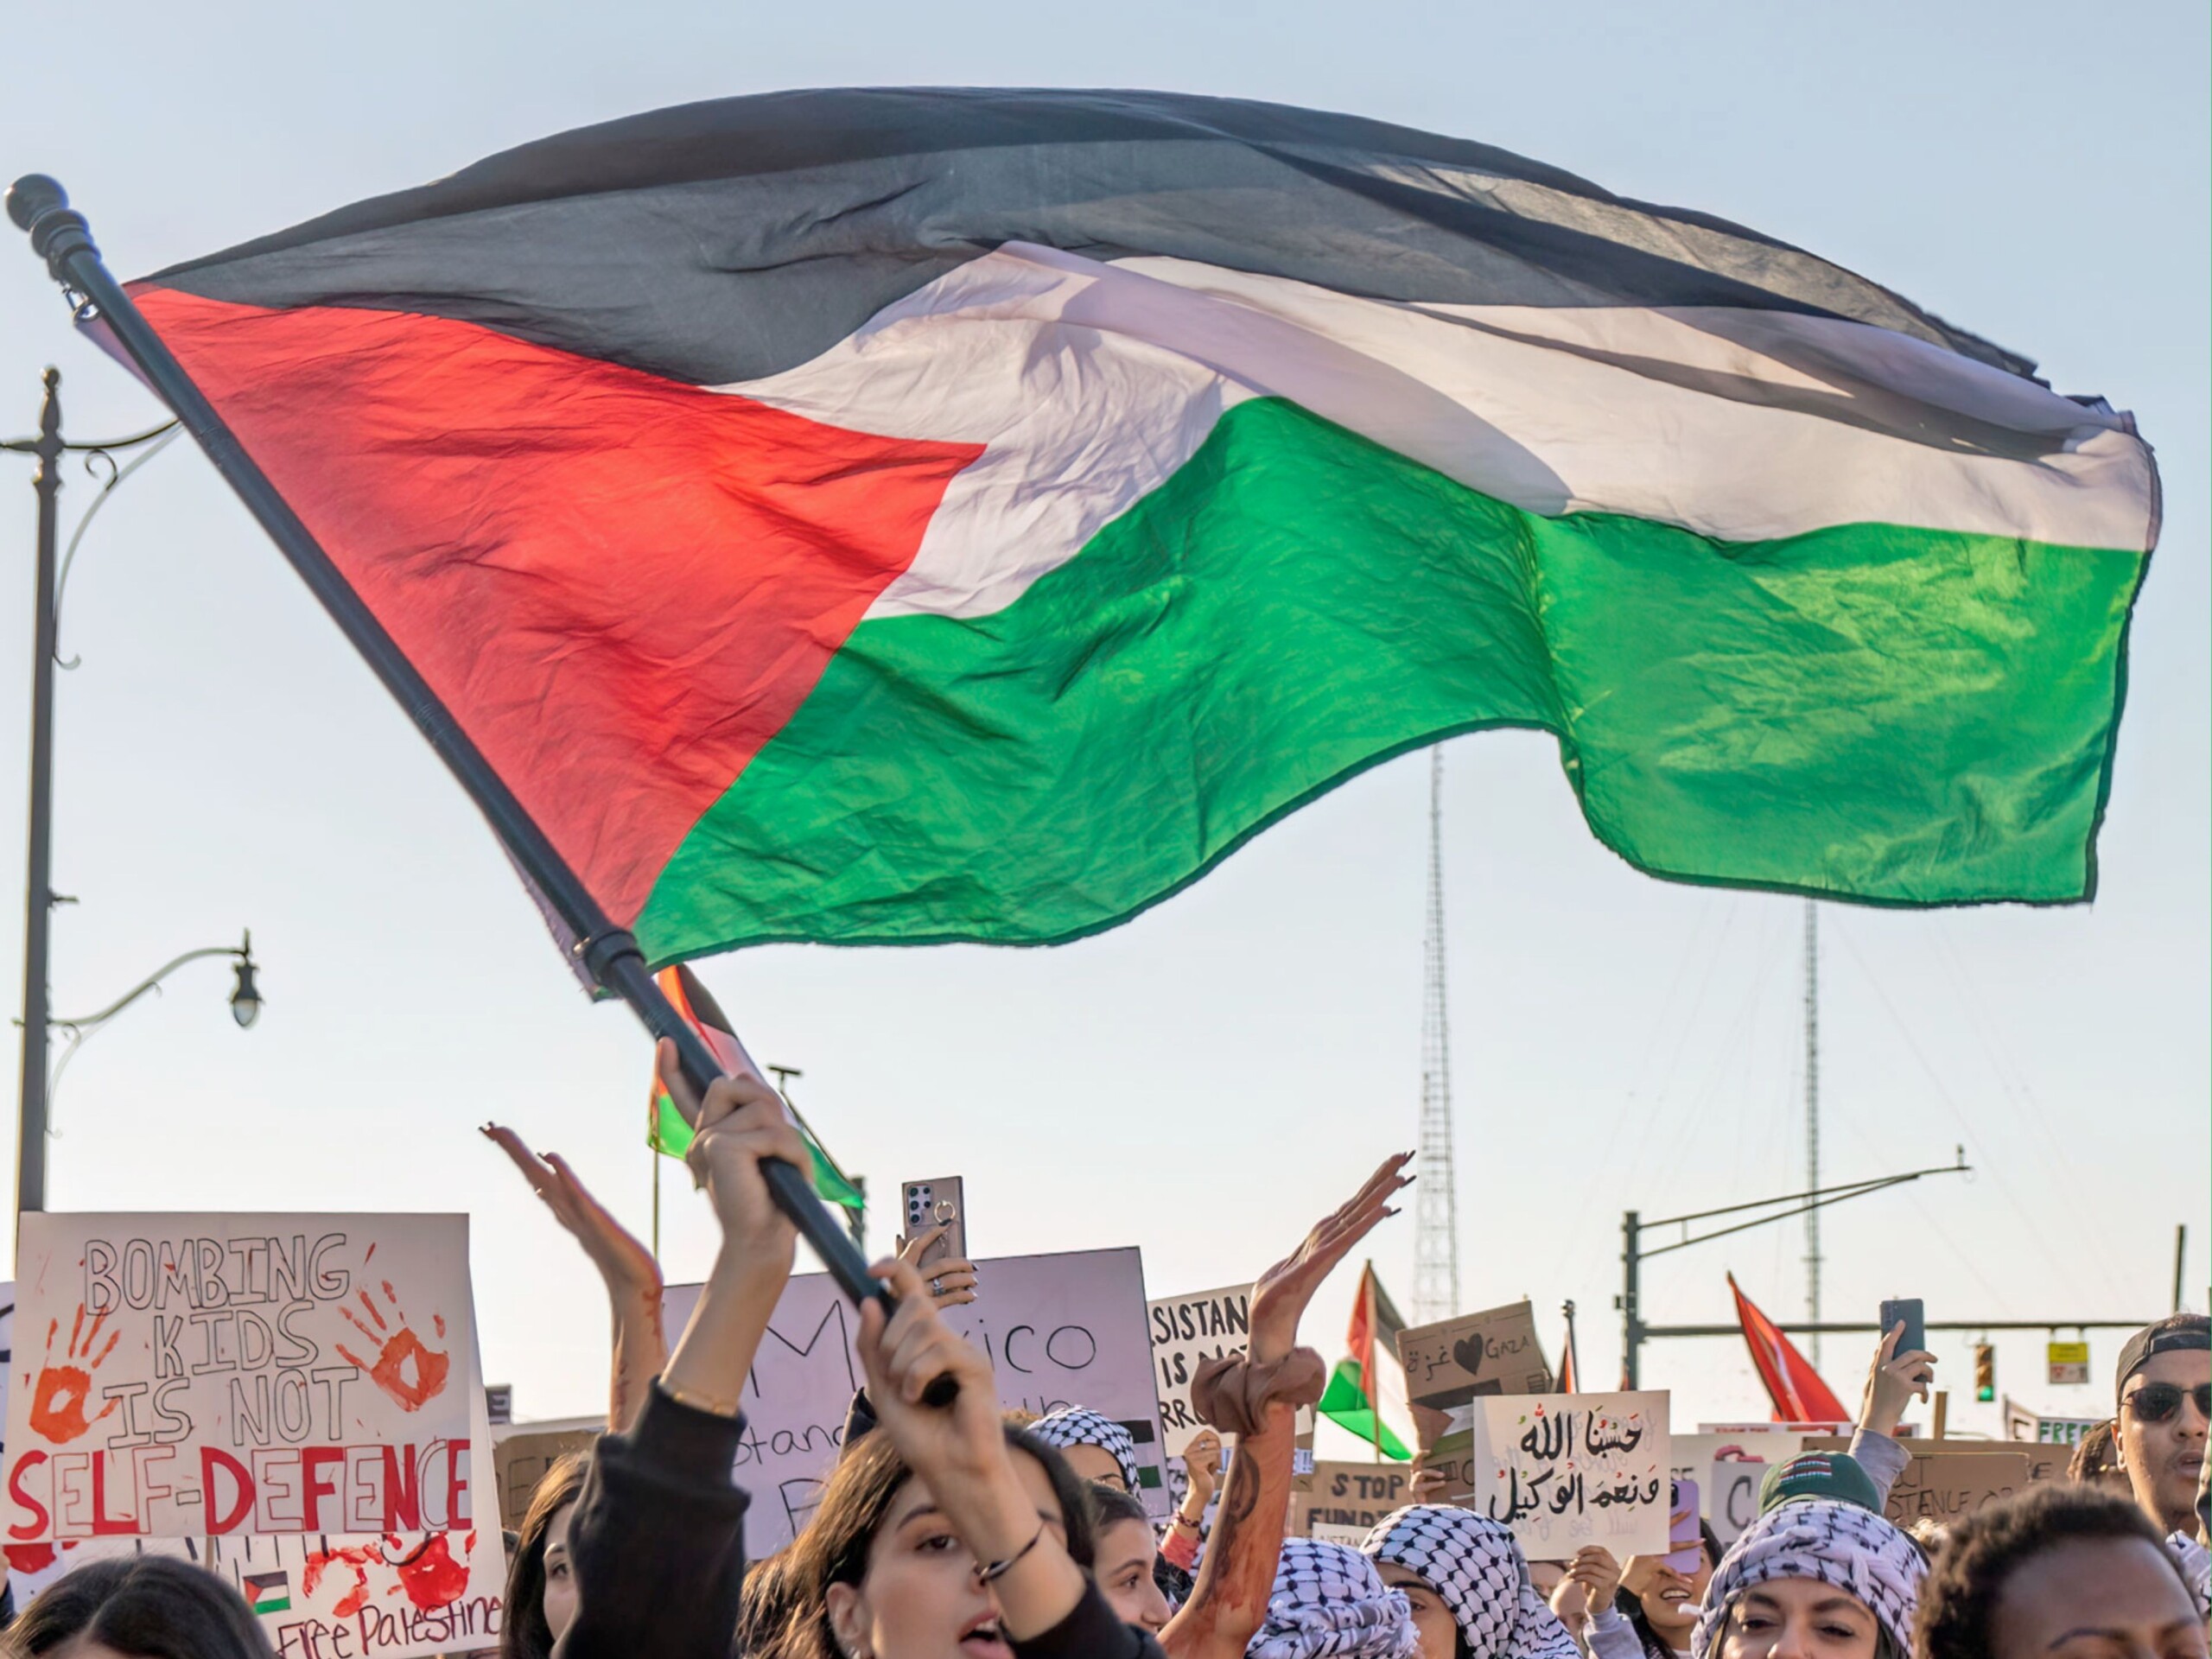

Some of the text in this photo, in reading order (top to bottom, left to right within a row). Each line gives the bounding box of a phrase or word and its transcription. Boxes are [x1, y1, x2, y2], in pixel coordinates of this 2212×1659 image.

[85, 1233, 350, 1316] BOMBING
[153, 1299, 320, 1379] KIDS
[1151, 1294, 1249, 1348] SISTAN
[1484, 1335, 1530, 1360] GAZA
[1160, 1351, 1188, 1389] IS
[1407, 1344, 1452, 1382] غزة
[102, 1377, 193, 1450] IS
[230, 1366, 359, 1446] NOT
[8, 1439, 473, 1540] SELF-DEFENCE
[1331, 1473, 1405, 1500] STOP
[357, 1596, 502, 1656] Palestine
